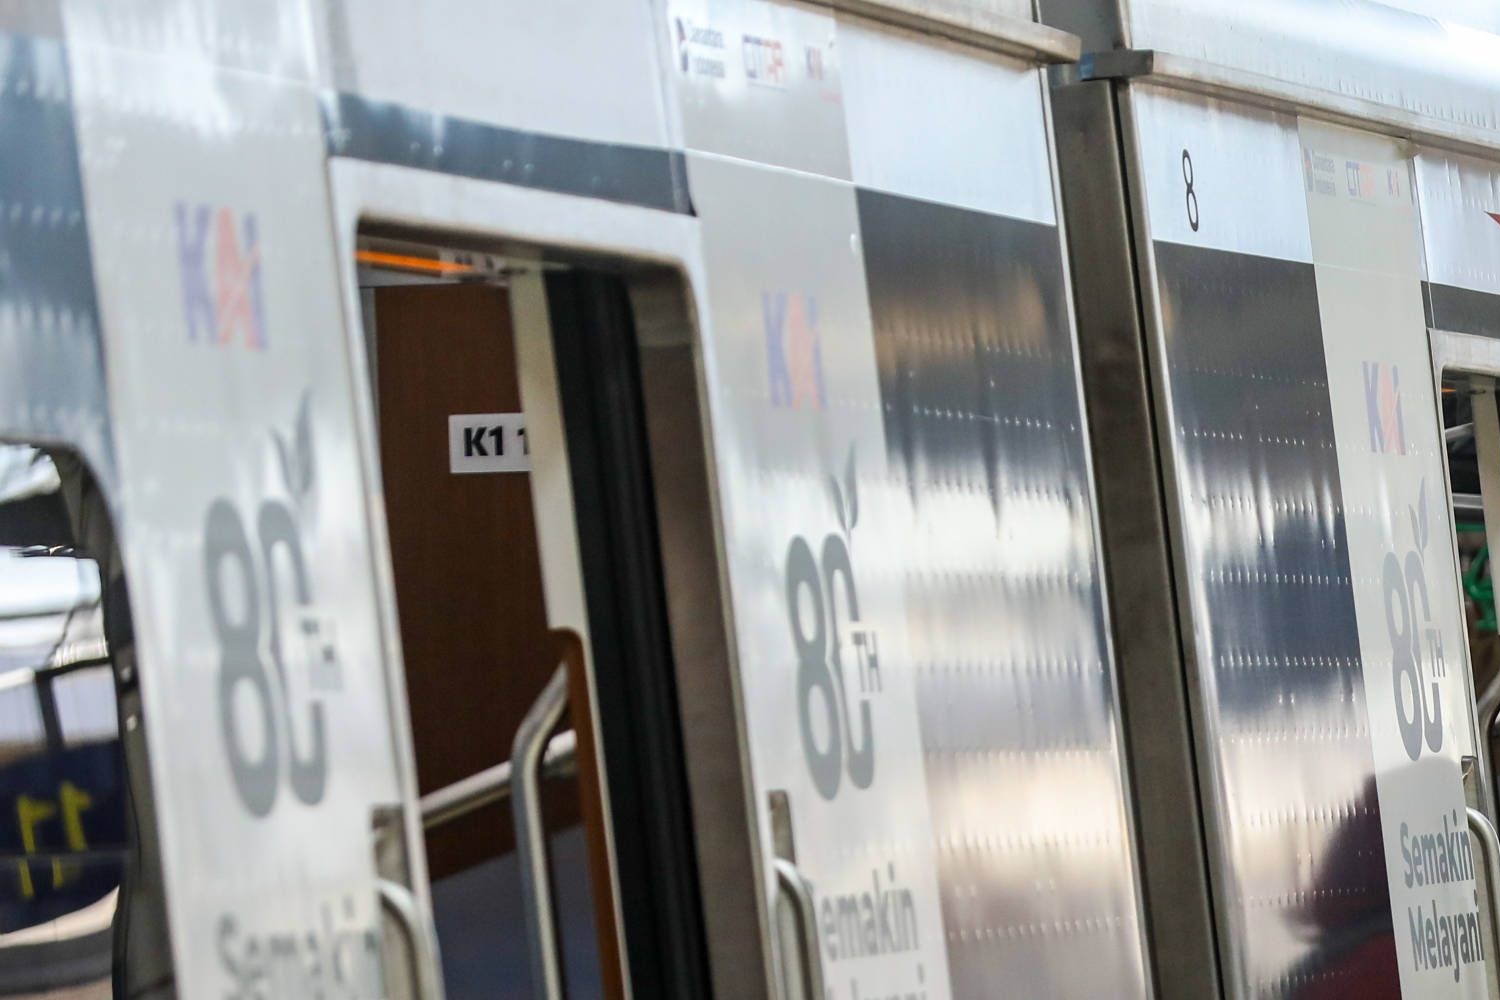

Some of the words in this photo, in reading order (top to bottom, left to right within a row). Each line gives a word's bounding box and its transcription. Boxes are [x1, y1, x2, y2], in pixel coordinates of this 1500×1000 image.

[1182, 148, 1199, 232] 8
[463, 425, 504, 457] K1
[1400, 808, 1475, 889] Semakin
[804, 861, 919, 962] emakin
[1408, 888, 1485, 984] Melayani
